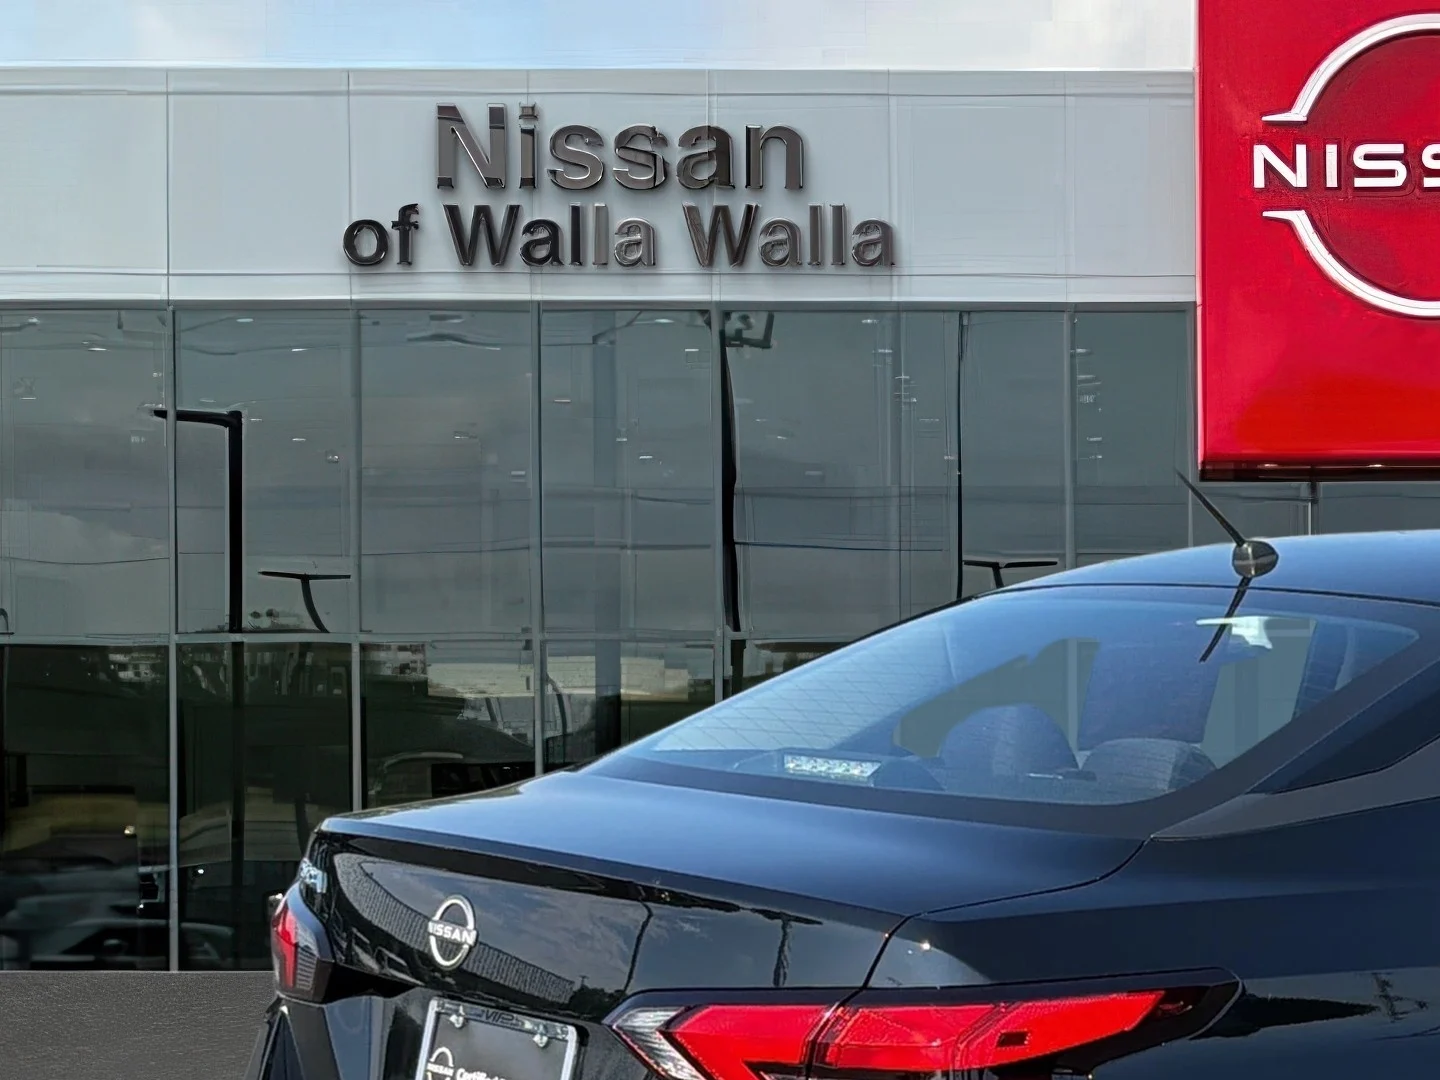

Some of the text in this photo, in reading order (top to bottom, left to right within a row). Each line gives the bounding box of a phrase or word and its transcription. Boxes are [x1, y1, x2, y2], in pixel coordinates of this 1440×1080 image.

[435, 102, 806, 190] Nissan
[343, 202, 896, 267] of Walla Walla
